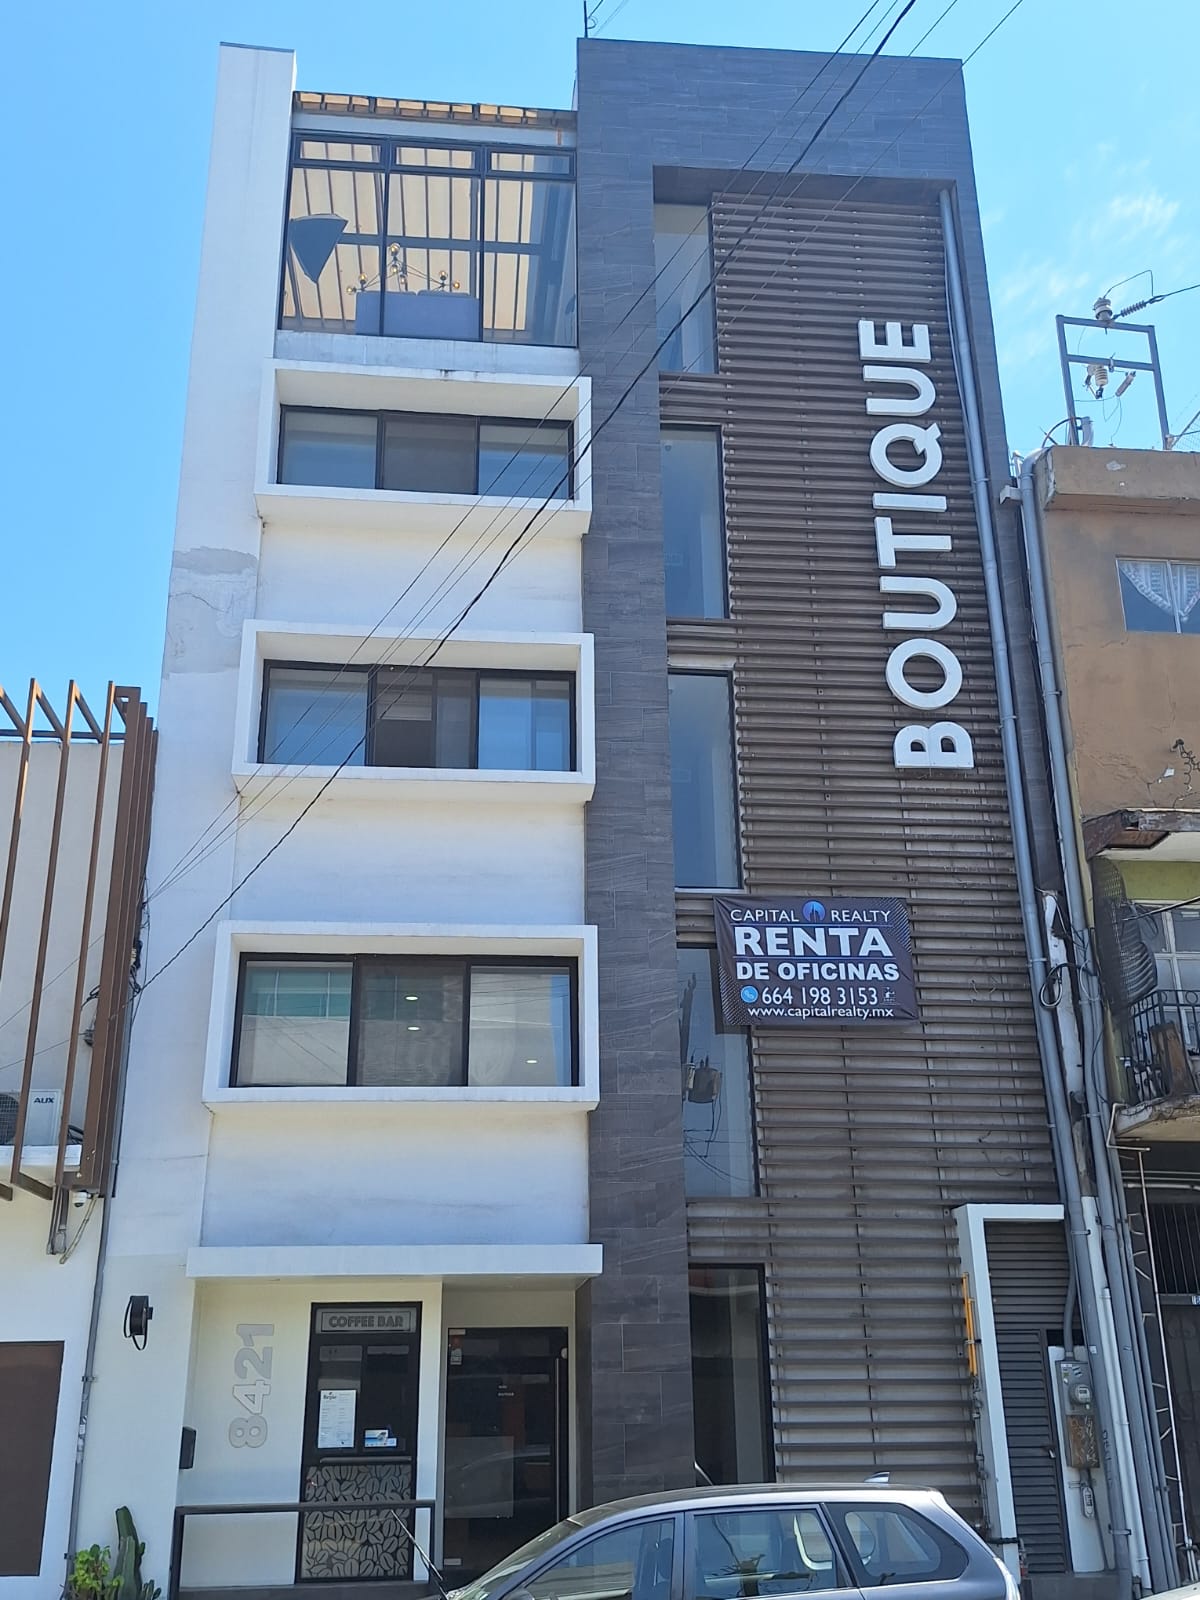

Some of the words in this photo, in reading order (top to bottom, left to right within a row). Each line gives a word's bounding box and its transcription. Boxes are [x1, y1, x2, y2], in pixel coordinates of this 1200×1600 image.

[858, 320, 974, 769] BOUTIQUE
[730, 909, 800, 922] CAPITAL
[831, 910, 891, 923] REALTY
[734, 926, 893, 957] RENTA
[736, 962, 770, 980] DE
[777, 962, 900, 981] OFICINAS
[761, 986, 793, 1005] 664
[802, 986, 831, 1005] 198
[837, 986, 878, 1005] 3153
[748, 1005, 894, 1020] www.capitalrealty.mx
[328, 1315, 375, 1328] COFFEE
[377, 1315, 404, 1328] BAR
[228, 1323, 275, 1448] 8421
